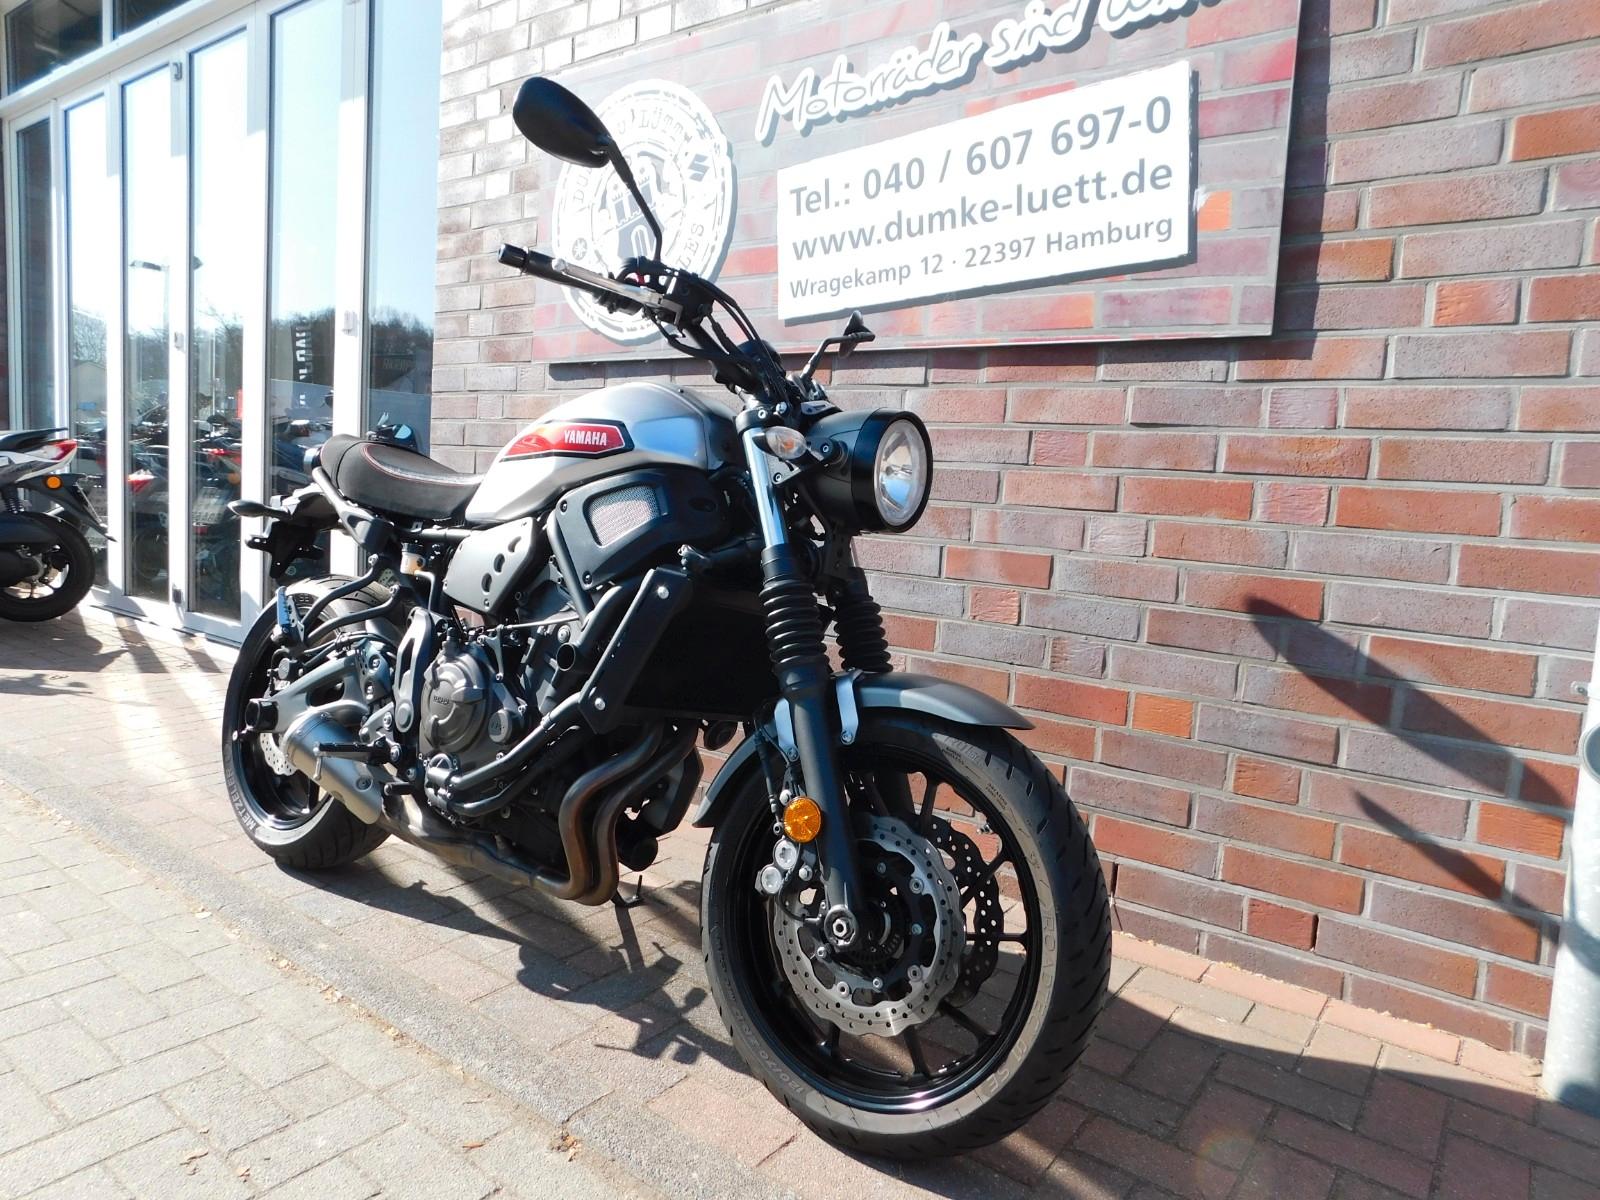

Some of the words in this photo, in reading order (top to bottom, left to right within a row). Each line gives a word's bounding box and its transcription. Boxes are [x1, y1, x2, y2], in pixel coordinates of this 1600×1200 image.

[757, 26, 979, 138] Motorräder
[985, 0, 1087, 62] sind
[789, 178, 850, 216] Tel.:
[863, 157, 925, 200] 040
[938, 149, 952, 184] /
[966, 129, 1033, 176] 607
[1050, 95, 1171, 156] 697-0
[789, 267, 912, 299] Wragekamp
[920, 254, 944, 276] 12
[964, 236, 1036, 268] 22397
[1046, 218, 1173, 254] Hamburg
[792, 158, 1173, 261] www.dumke-luett.de
[564, 430, 608, 446] YAMAHA
